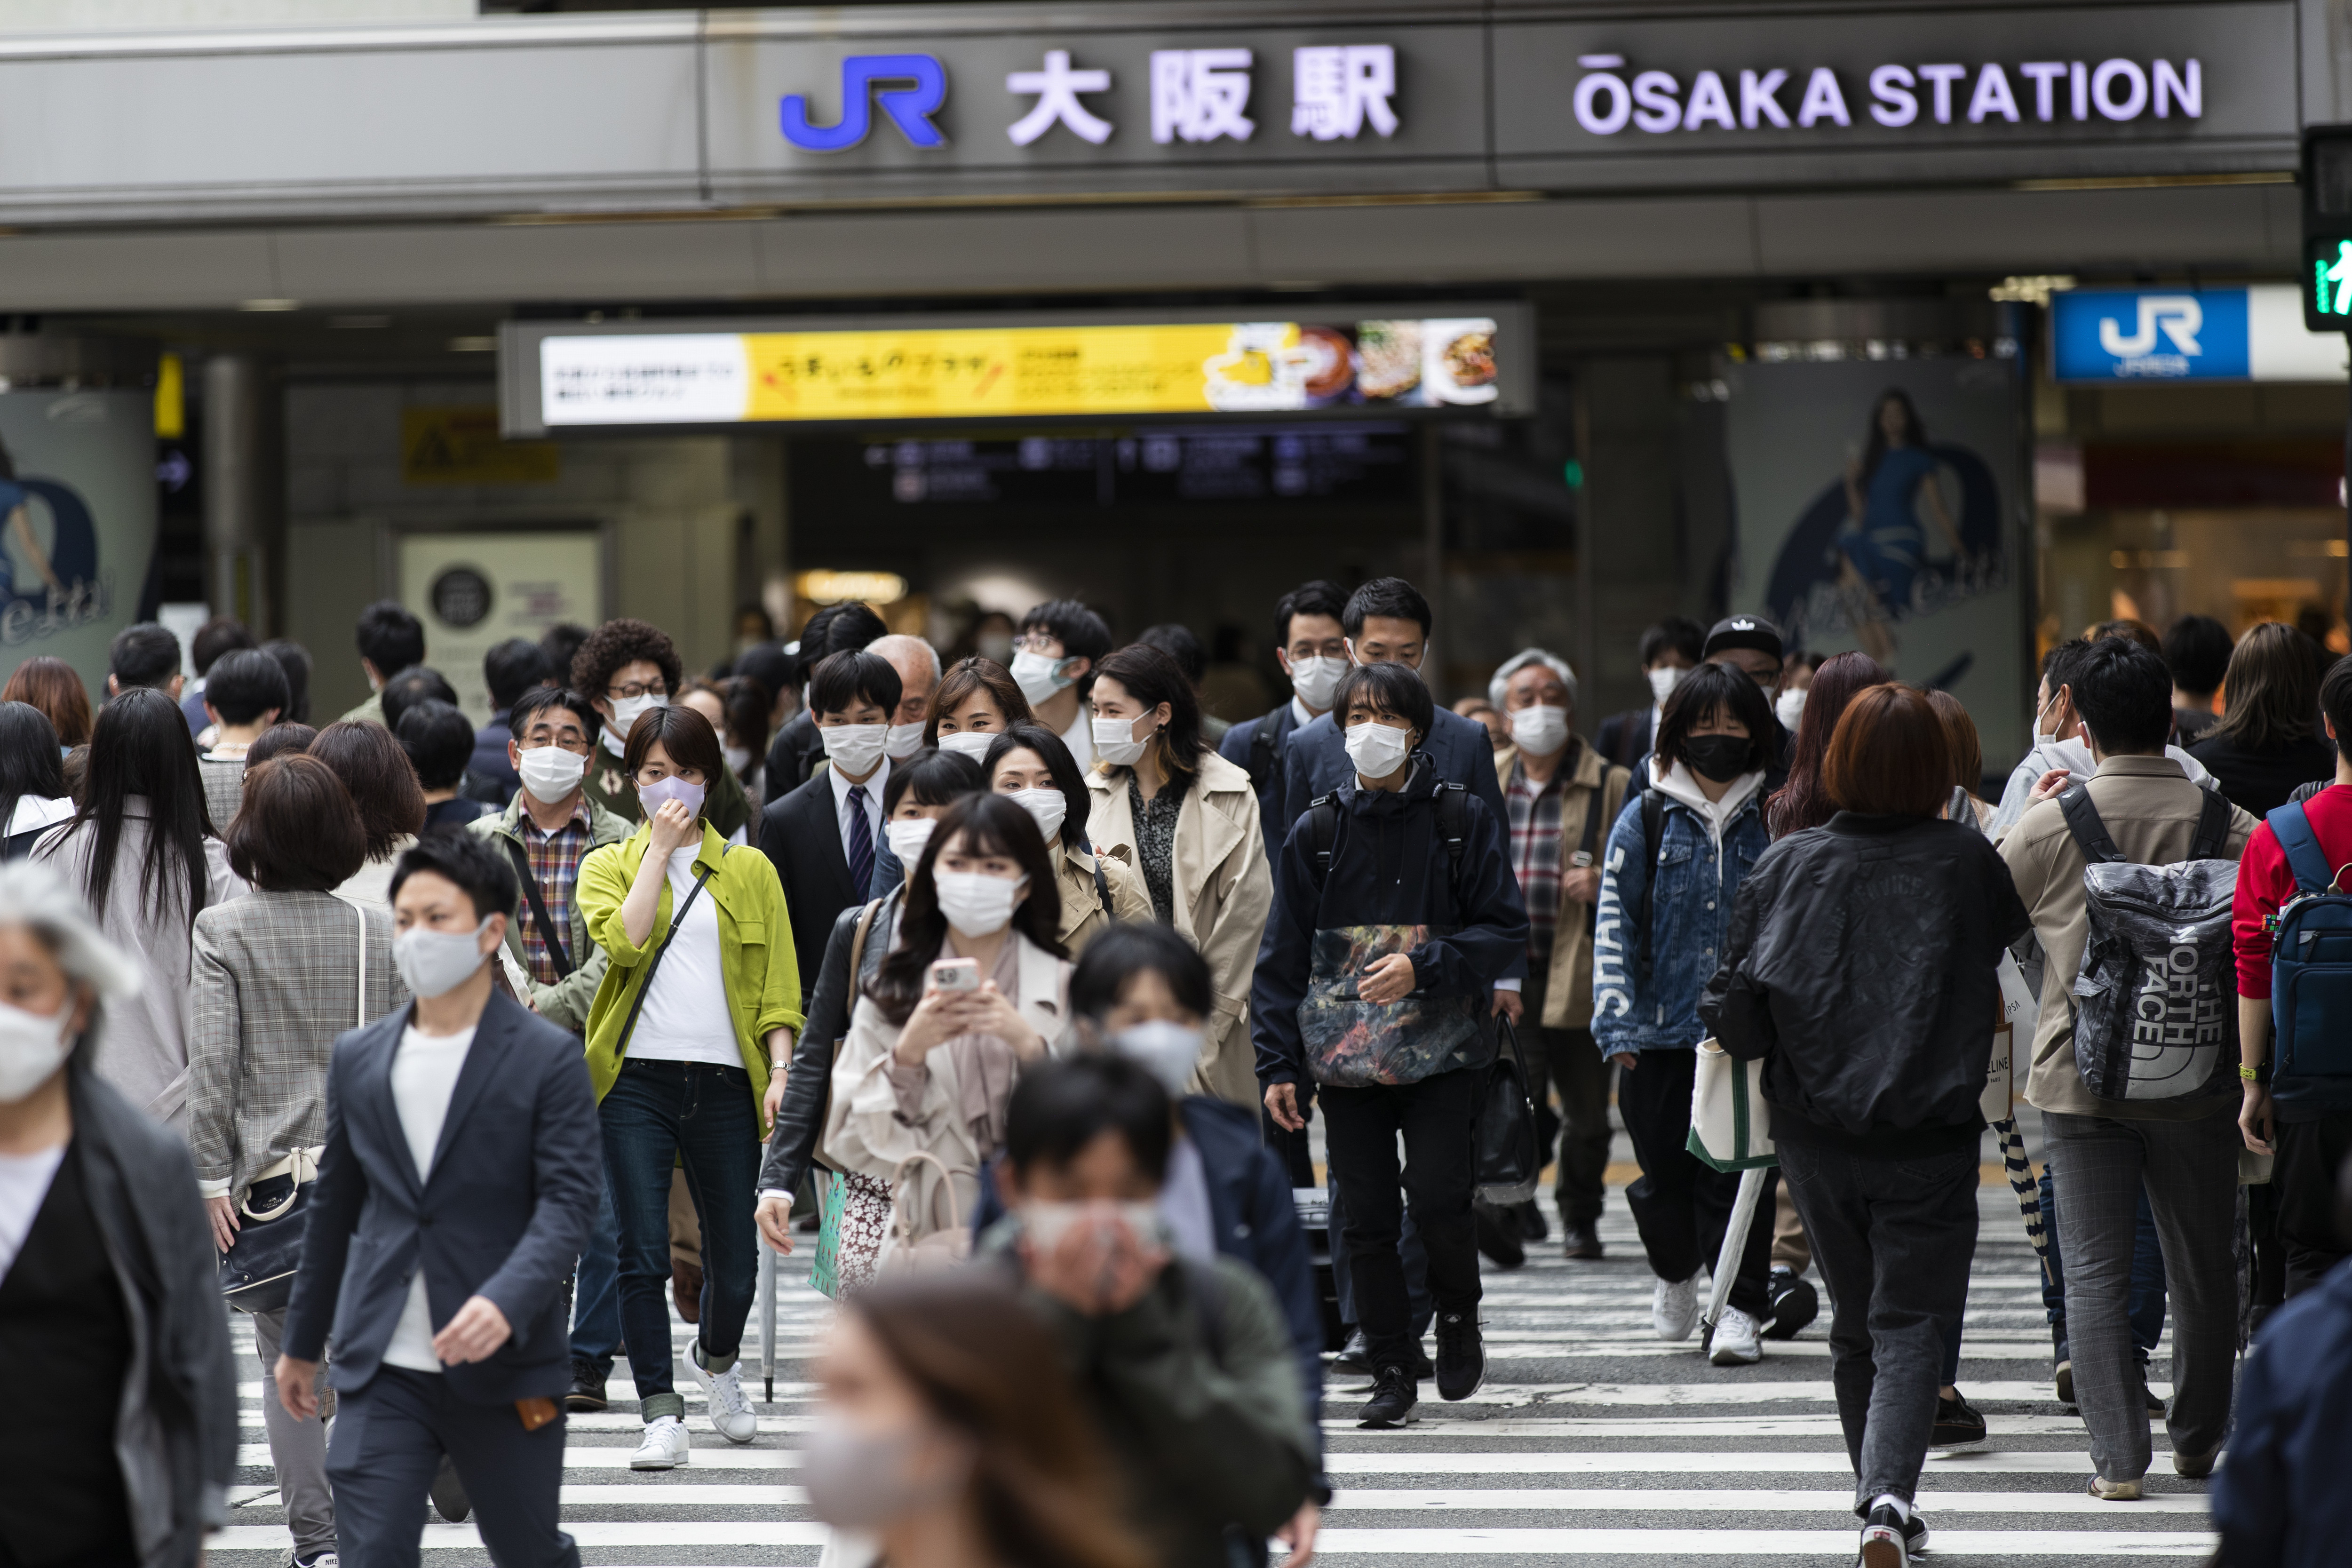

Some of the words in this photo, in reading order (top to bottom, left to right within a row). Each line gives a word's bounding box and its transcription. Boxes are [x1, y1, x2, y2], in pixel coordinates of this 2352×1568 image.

[779, 54, 946, 151] JR
[1006, 46, 1395, 145] 大阪駅
[1573, 55, 1849, 134] ŌSAKA
[1870, 58, 2202, 126] STATION
[2099, 295, 2202, 356] JR
[2005, 1000, 2021, 1016] IPSA
[2133, 955, 2168, 1043] FACE
[2164, 926, 2199, 1044] NORTH
[2195, 977, 2223, 1044] THE
